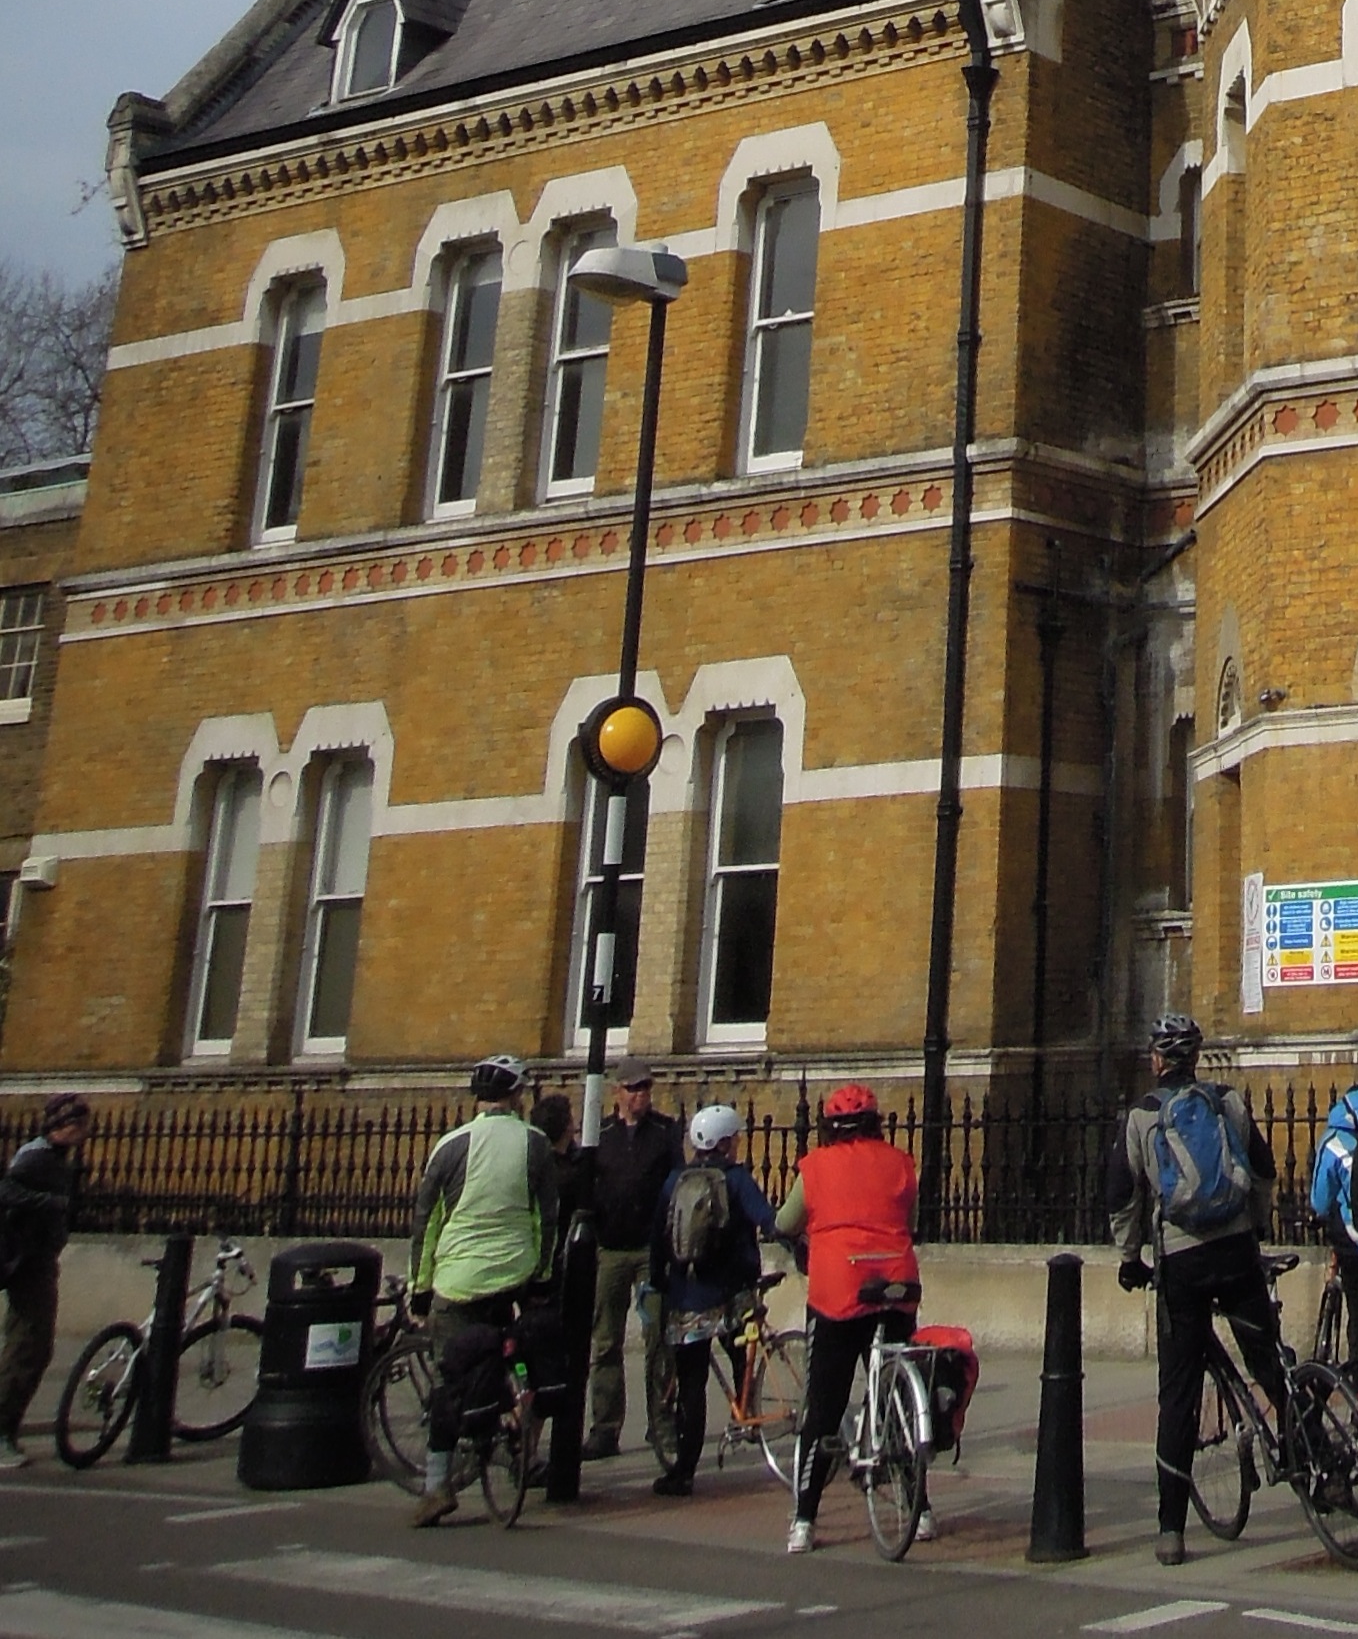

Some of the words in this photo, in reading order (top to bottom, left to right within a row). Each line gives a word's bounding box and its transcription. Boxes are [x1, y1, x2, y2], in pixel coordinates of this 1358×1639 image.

[1280, 890, 1296, 899] Site
[1298, 889, 1322, 899] safety
[592, 988, 601, 1001] 7
